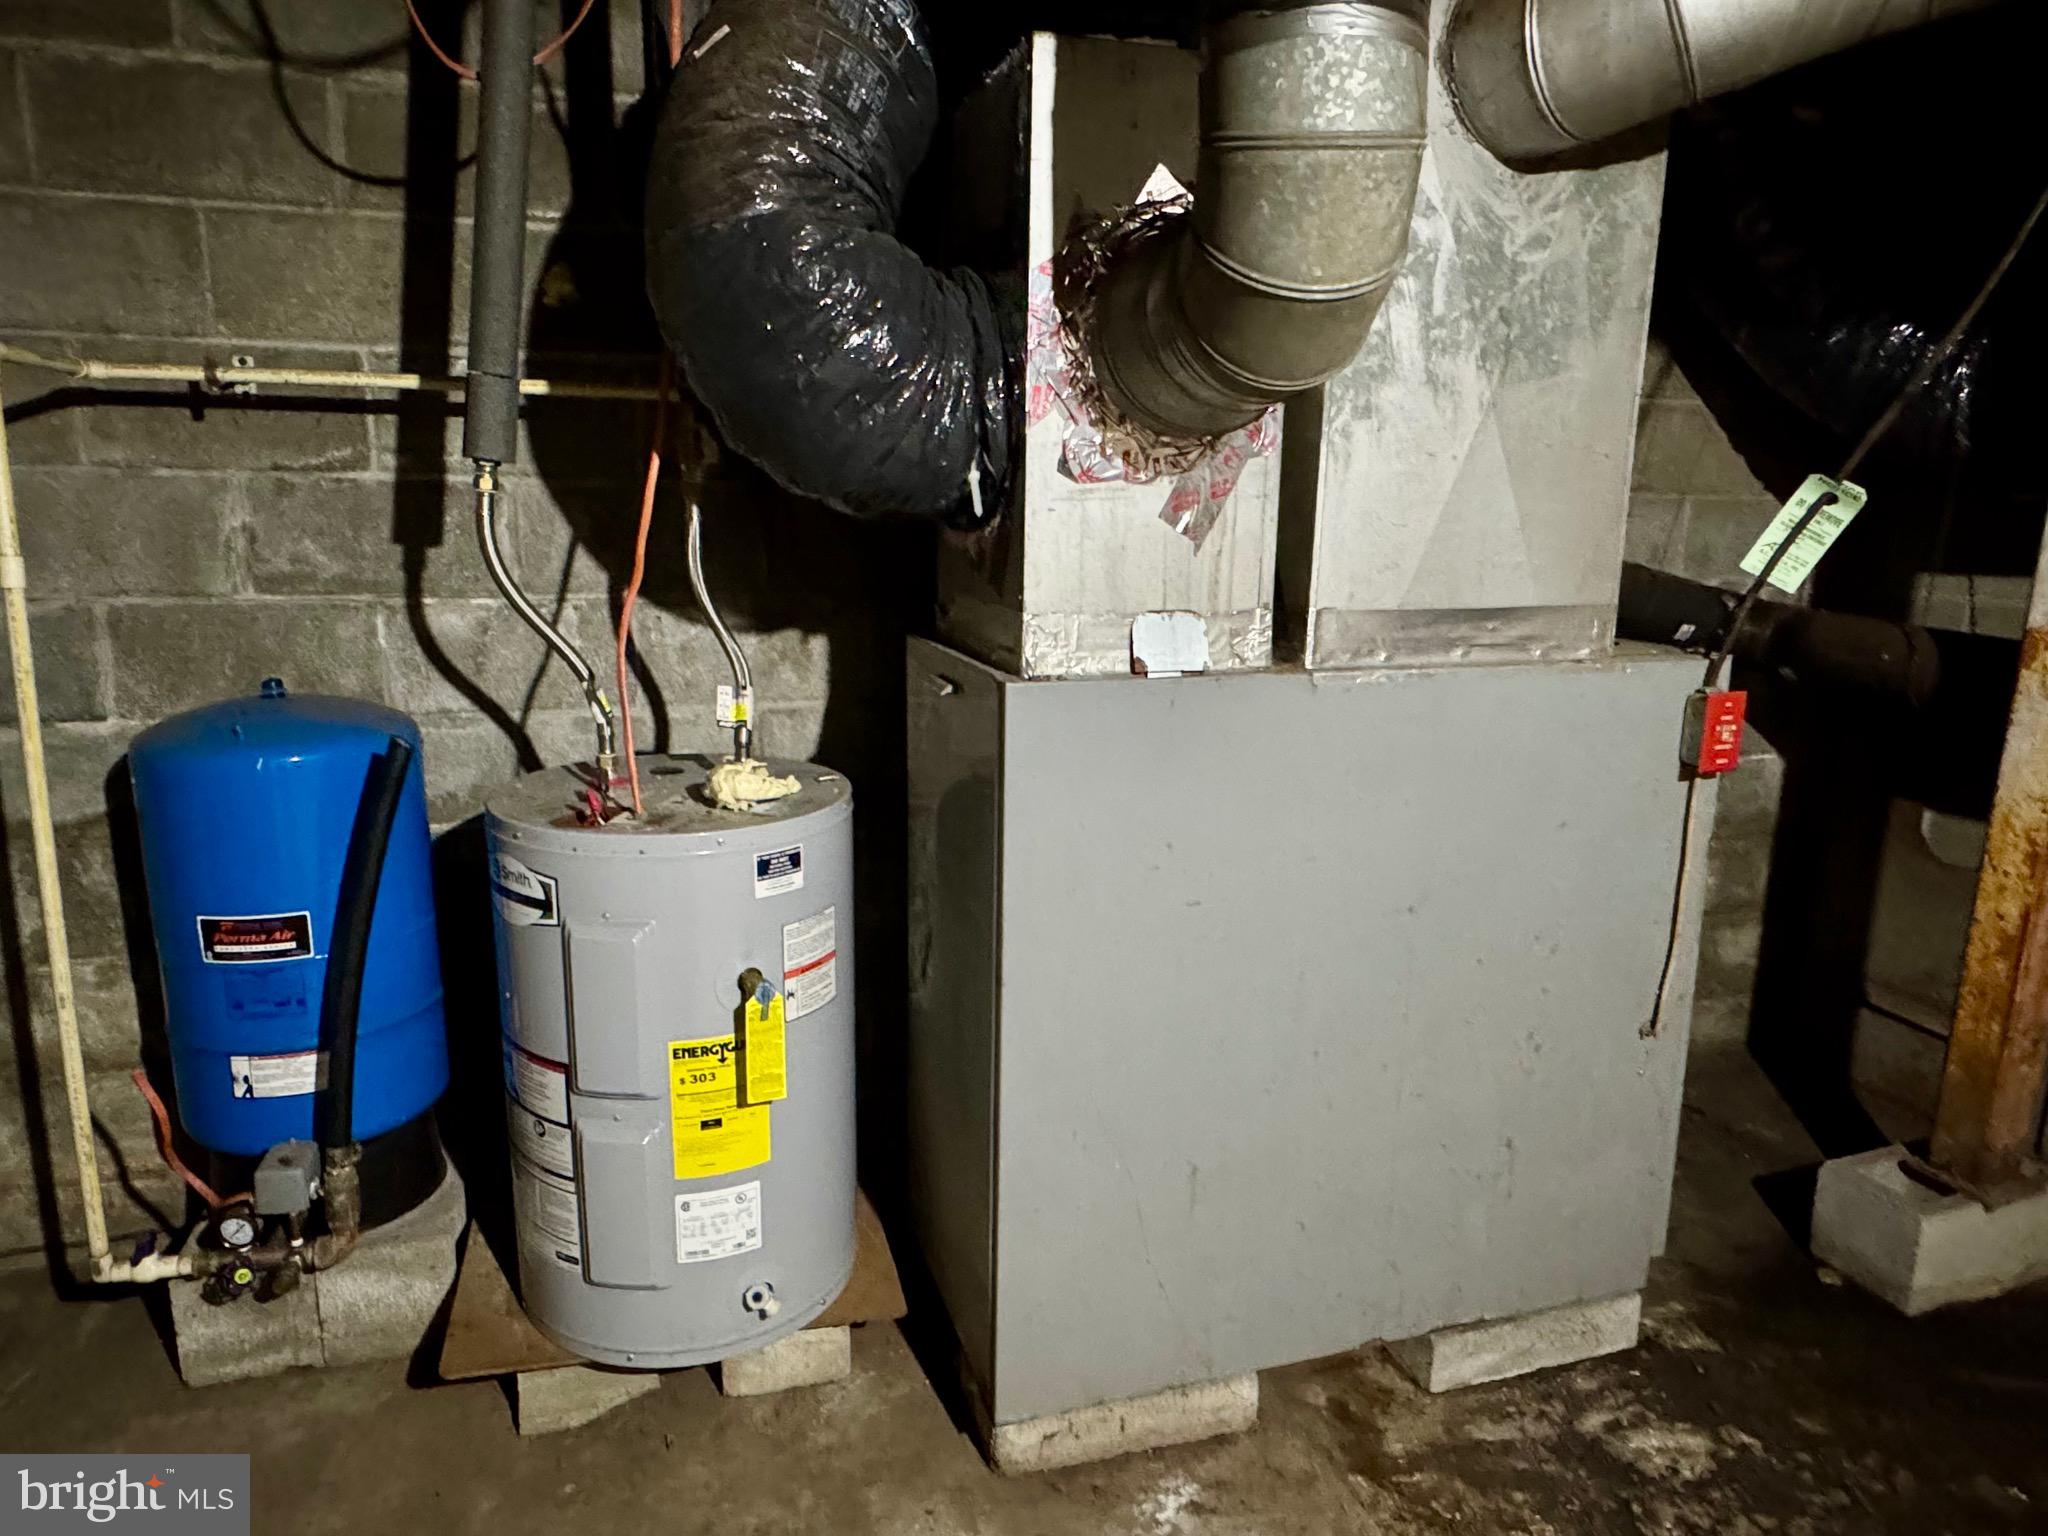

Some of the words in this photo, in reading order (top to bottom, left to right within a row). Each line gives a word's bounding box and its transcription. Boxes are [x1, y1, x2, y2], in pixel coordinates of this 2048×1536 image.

[501, 864, 532, 888] Smith
[672, 1040, 745, 1063] ENERGYGU
[679, 1077, 686, 1085] $
[690, 1072, 717, 1084] 303
